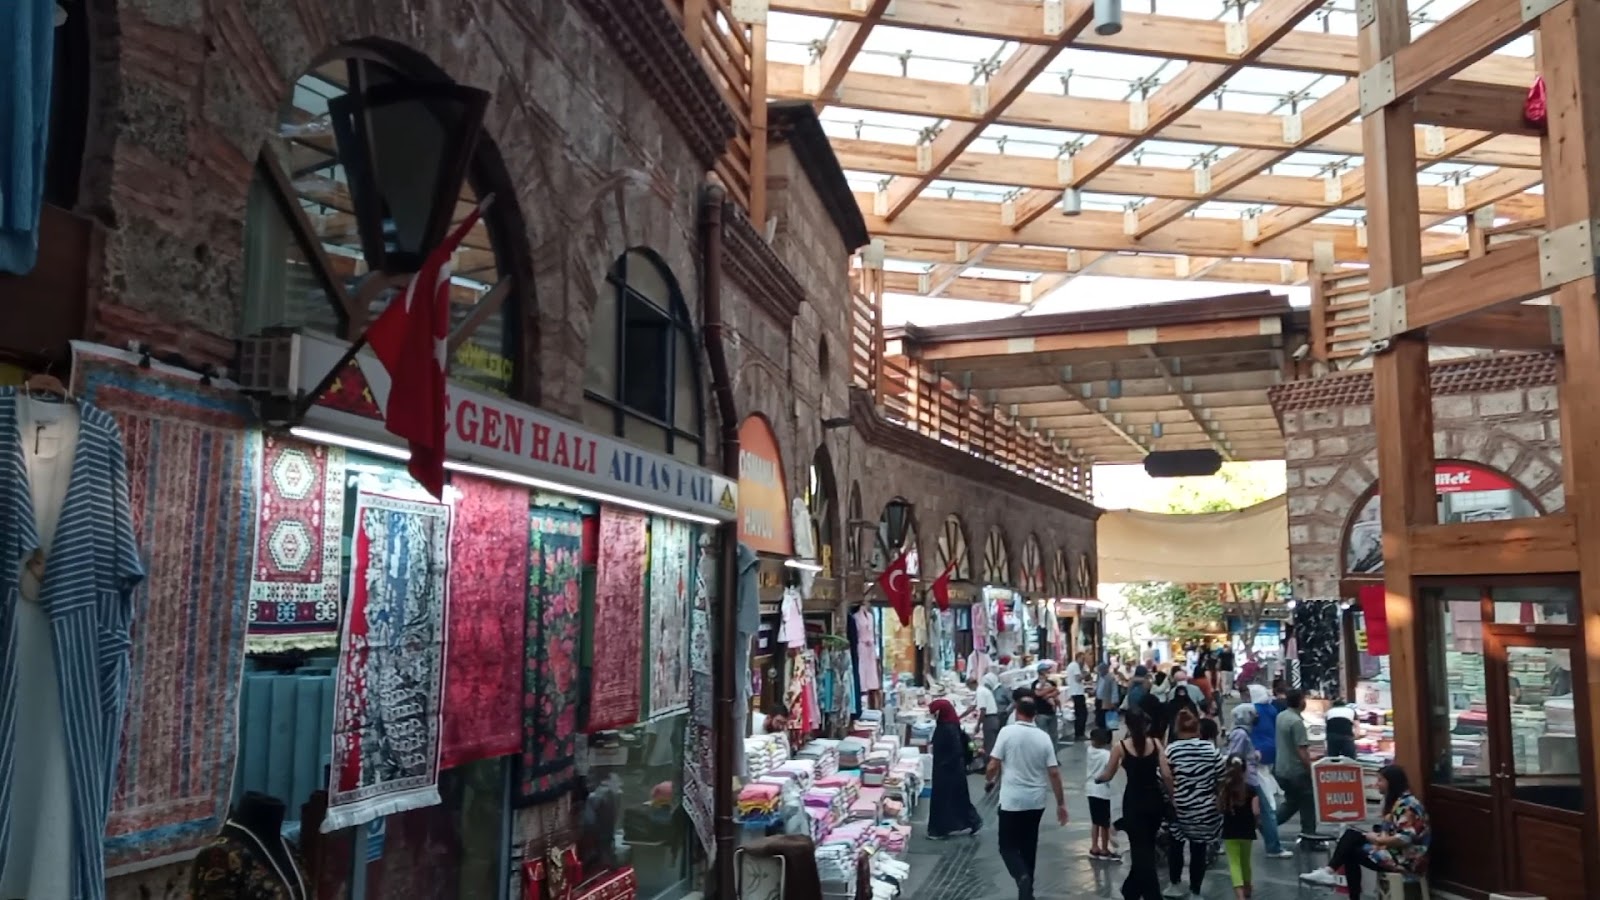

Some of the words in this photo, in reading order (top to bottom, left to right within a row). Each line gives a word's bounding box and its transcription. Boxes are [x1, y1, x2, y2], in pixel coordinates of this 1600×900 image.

[530, 422, 598, 475] HALI
[1319, 770, 1357, 784] OSMANLI
[1326, 792, 1354, 805] HAVLU
